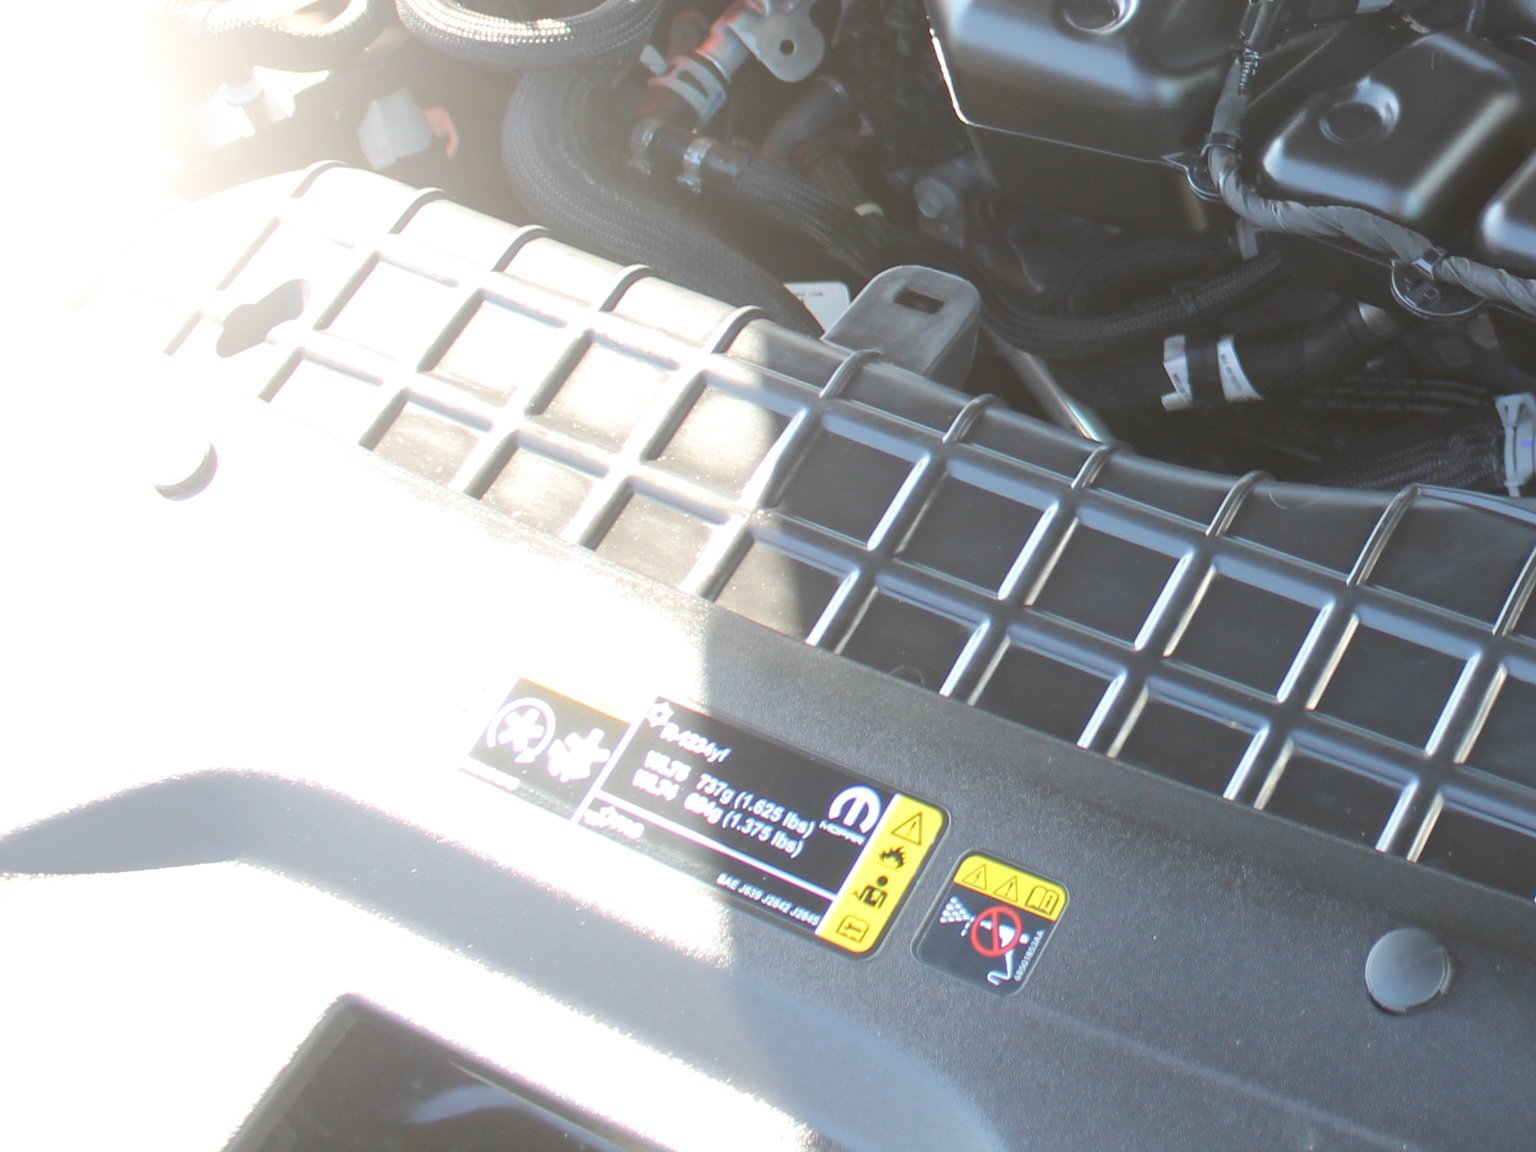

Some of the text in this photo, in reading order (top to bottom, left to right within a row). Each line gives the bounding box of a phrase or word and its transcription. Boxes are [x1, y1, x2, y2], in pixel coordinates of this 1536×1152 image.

[696, 773, 736, 805] 737g
[734, 791, 786, 823] (1.625
[782, 810, 816, 839] lbs)
[721, 810, 774, 841] (1.375
[770, 829, 805, 858] lbs)
[819, 820, 866, 846] MOPAR
[716, 873, 740, 890] SAE
[738, 882, 763, 901] J639
